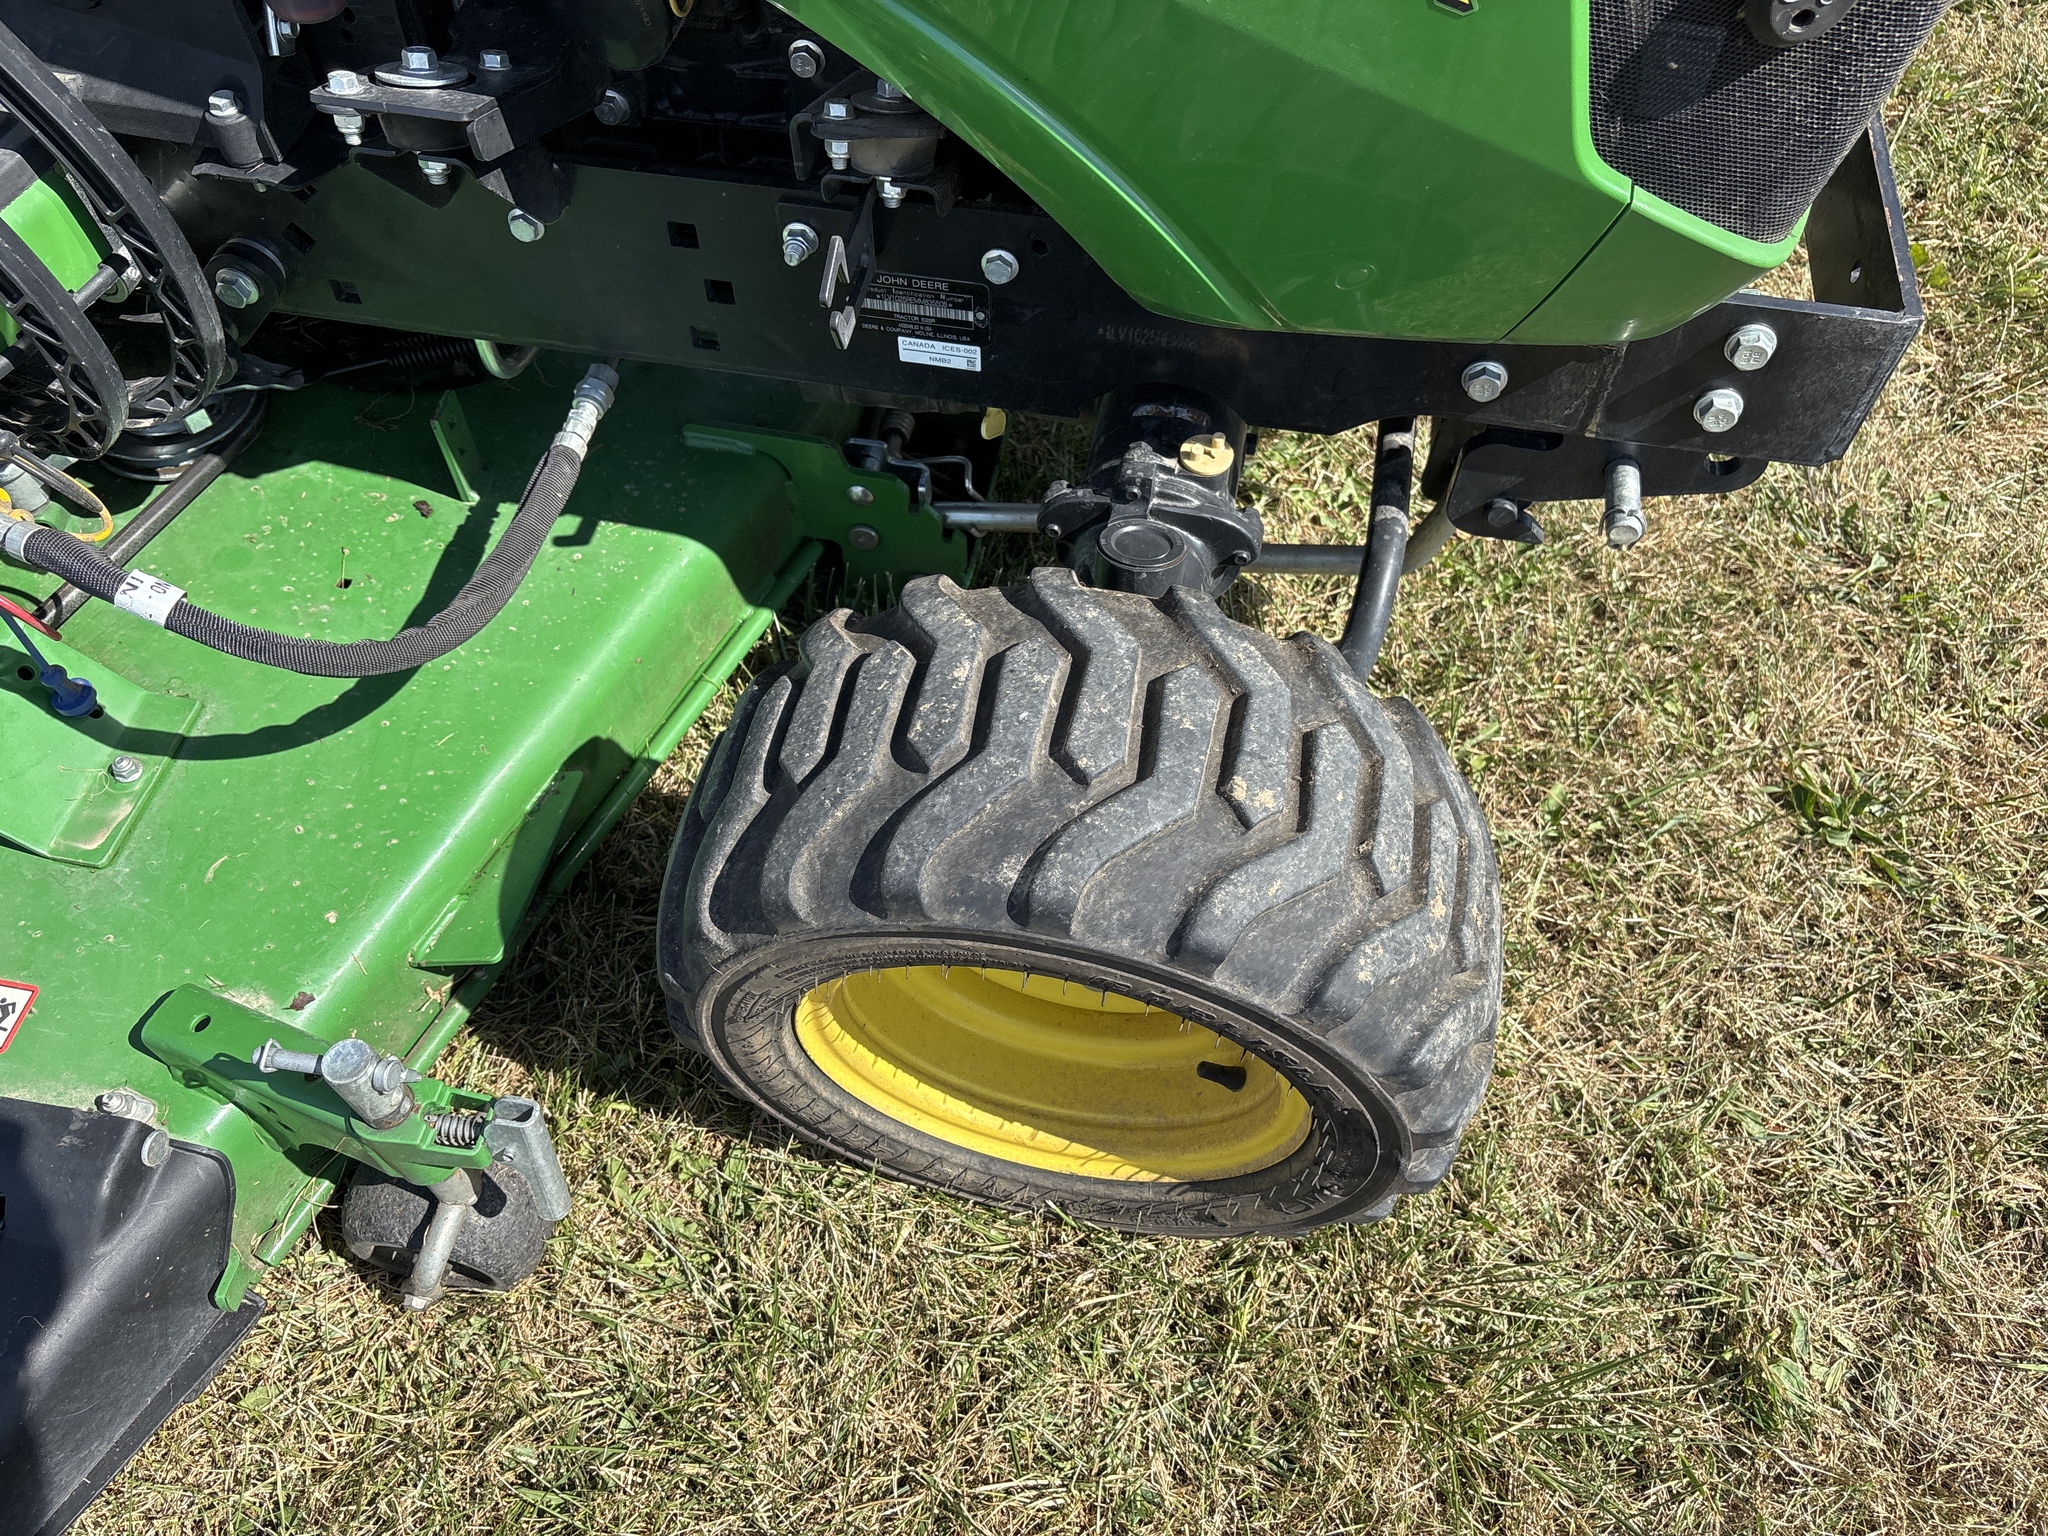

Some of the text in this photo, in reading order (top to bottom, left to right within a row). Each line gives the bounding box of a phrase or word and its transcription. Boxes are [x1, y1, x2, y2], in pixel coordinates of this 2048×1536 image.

[876, 275, 950, 291] JOHN DEERE
[867, 286, 888, 294] roduct
[940, 293, 965, 303] Number
[893, 313, 920, 321] TRACTOR
[861, 323, 879, 331] DEERE
[901, 339, 978, 356] CANADA ICES-002
[928, 355, 952, 365] NMB2
